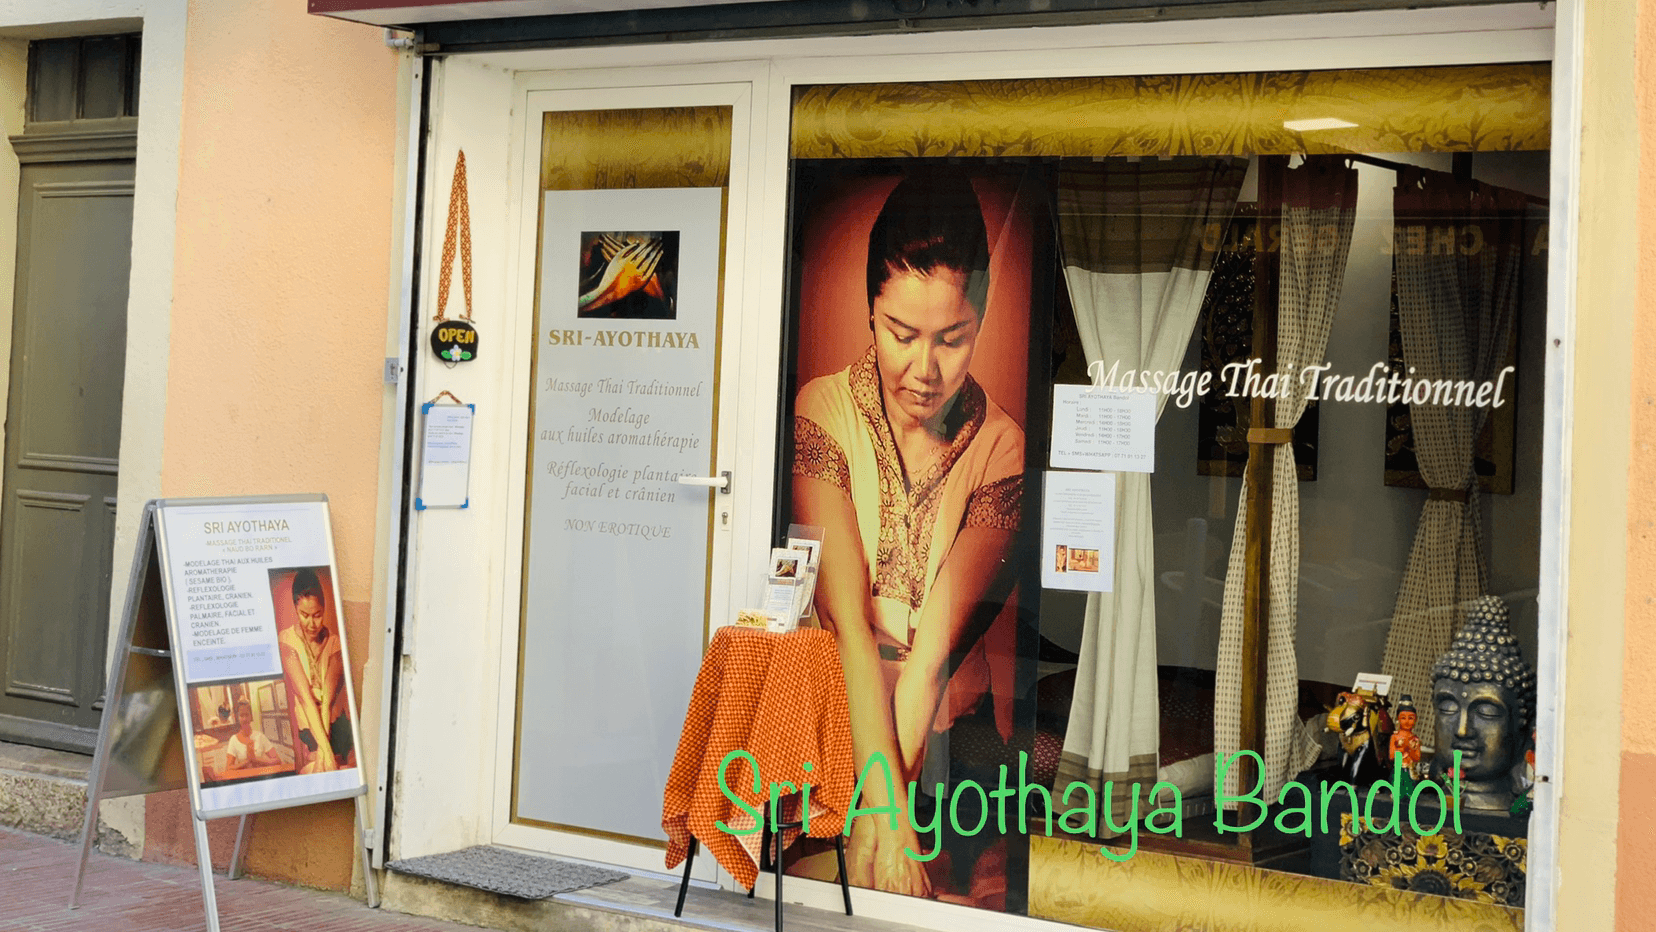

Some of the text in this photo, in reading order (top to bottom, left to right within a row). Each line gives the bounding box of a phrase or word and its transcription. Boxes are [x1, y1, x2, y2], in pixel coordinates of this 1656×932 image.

[438, 328, 475, 344] OPEN
[548, 329, 700, 349] SRI-AYOTHAYA
[545, 377, 703, 398] Massage Thai Traditionnel
[1086, 358, 1515, 408] Massage Thai Traditionnel
[588, 406, 650, 429] Modelage
[540, 426, 700, 453] aux huiles aromathérapie
[546, 460, 628, 483] Réflexologie
[561, 480, 676, 503] facial et crânien
[204, 519, 290, 535] SRI AYOTHAYA
[564, 518, 672, 540] NON EROTIQUE
[184, 567, 237, 576] AROMATHERAPIE
[241, 626, 263, 634] FEMME
